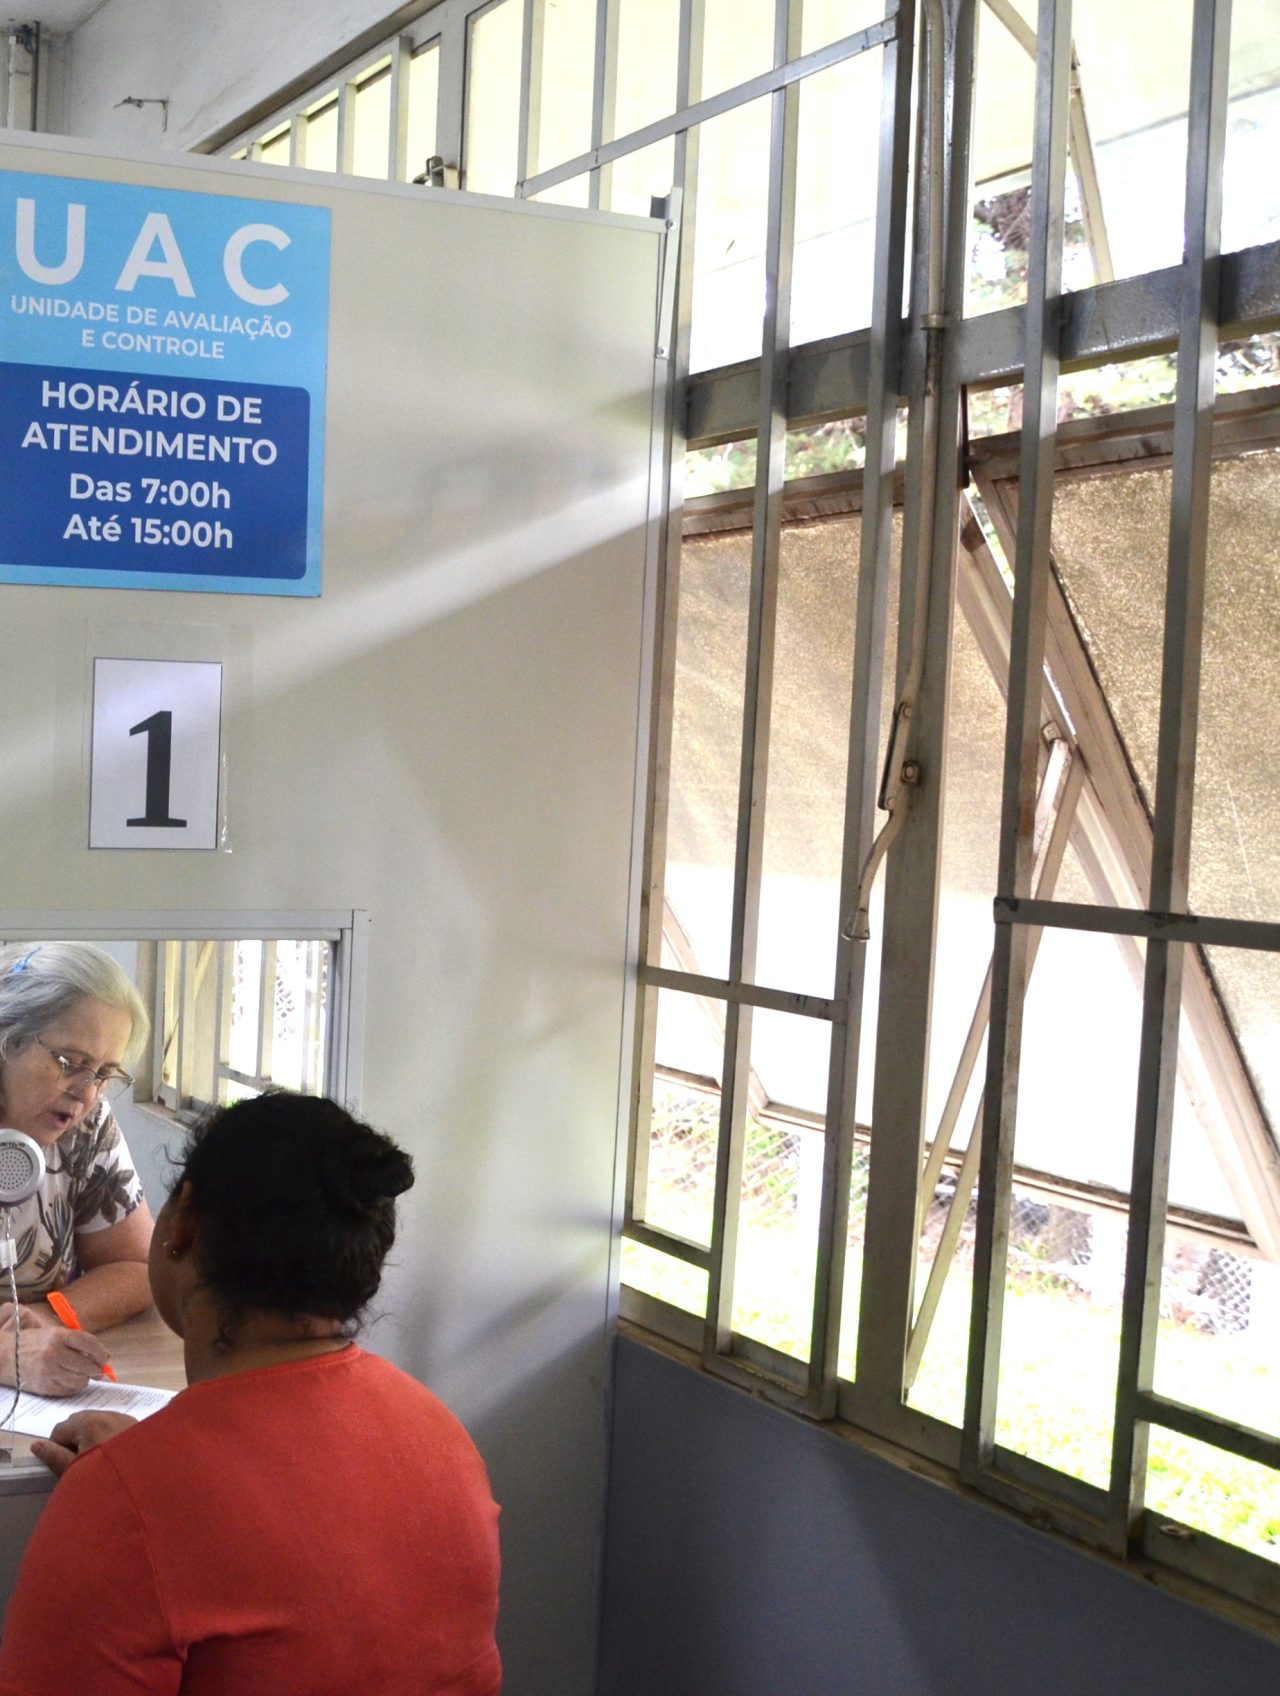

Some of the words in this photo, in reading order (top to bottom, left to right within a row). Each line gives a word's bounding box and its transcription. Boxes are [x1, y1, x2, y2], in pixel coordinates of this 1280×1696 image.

[11, 295, 120, 323] UNIDADE
[126, 306, 157, 327] DE
[163, 310, 293, 341] AVALIAÇÃO
[81, 328, 95, 348] E
[101, 331, 225, 360] CONTROLE
[42, 380, 207, 421] HORÁRIO
[217, 394, 263, 425] DE
[21, 421, 278, 467] ATENDIMENTO
[70, 473, 132, 504] Das
[141, 477, 231, 509] 7:00h
[63, 512, 121, 543] Até
[131, 517, 233, 549] 15:00h
[126, 710, 187, 828] 1
